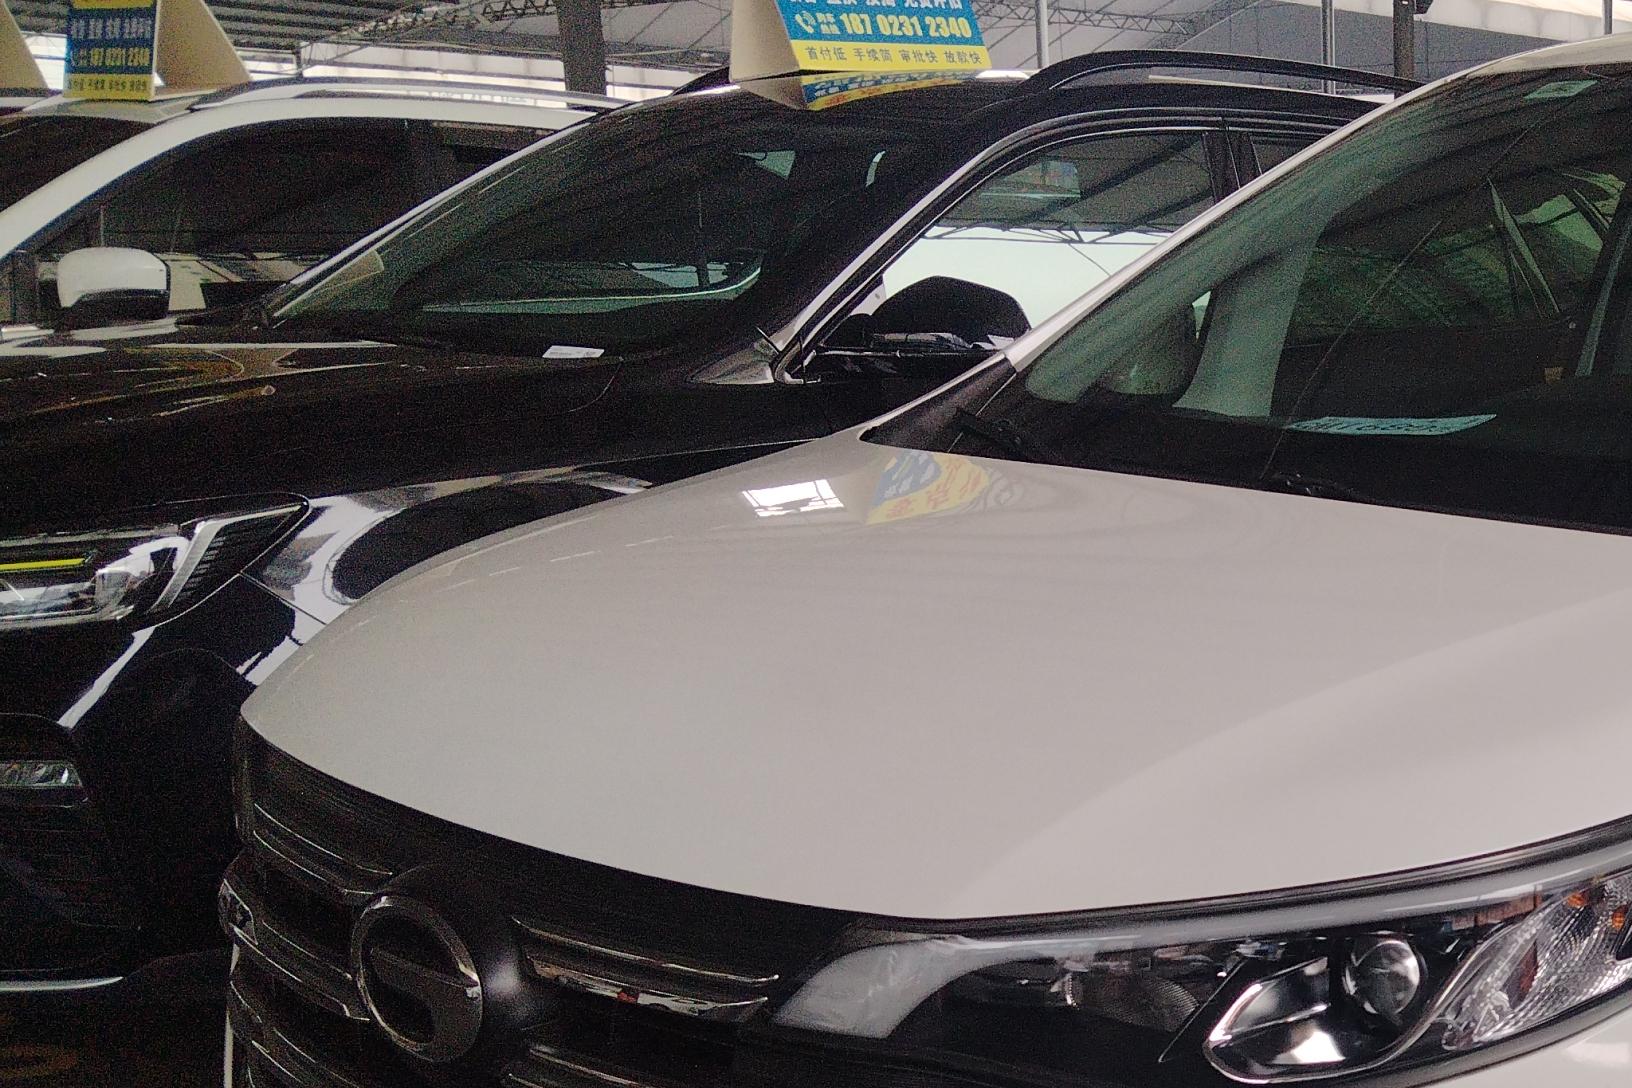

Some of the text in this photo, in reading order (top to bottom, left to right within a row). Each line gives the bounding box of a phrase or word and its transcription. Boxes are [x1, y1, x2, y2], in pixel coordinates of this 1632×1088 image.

[839, 12, 873, 35] 187
[876, 14, 923, 37] 0231
[925, 15, 972, 38] 2340
[806, 46, 848, 61] 首付低
[900, 49, 939, 63] 审批快
[944, 50, 982, 64] 放款快
